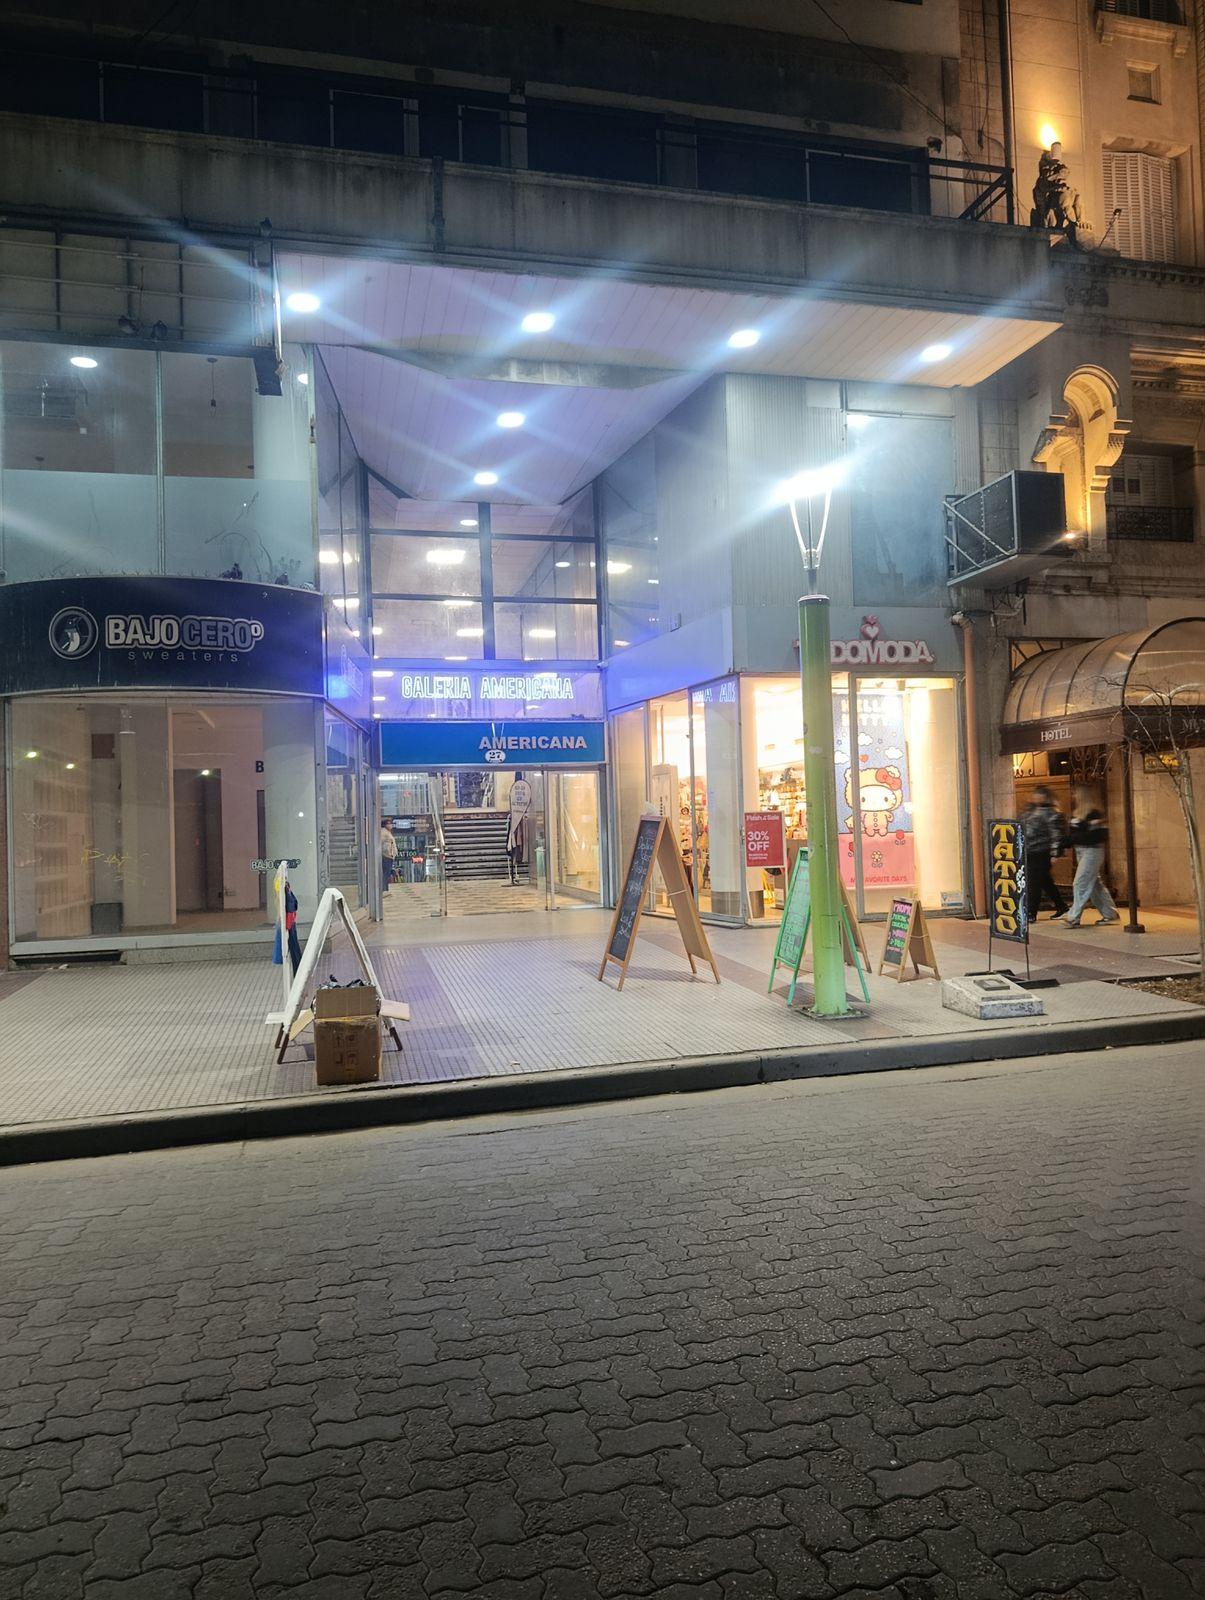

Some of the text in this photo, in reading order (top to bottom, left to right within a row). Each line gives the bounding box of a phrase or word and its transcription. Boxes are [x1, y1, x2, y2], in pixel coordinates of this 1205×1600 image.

[128, 650, 238, 663] sweaters
[792, 640, 934, 664] DOMODA
[401, 675, 574, 700] GALERIA AMERICANA
[1040, 728, 1072, 742] HOTEL
[479, 736, 588, 750] AMERICANA
[489, 751, 501, 759] 27
[747, 830, 770, 841] 30%
[748, 841, 770, 851] OFF
[864, 875, 890, 884] AVORITE
[992, 824, 1018, 936] TATTOO
